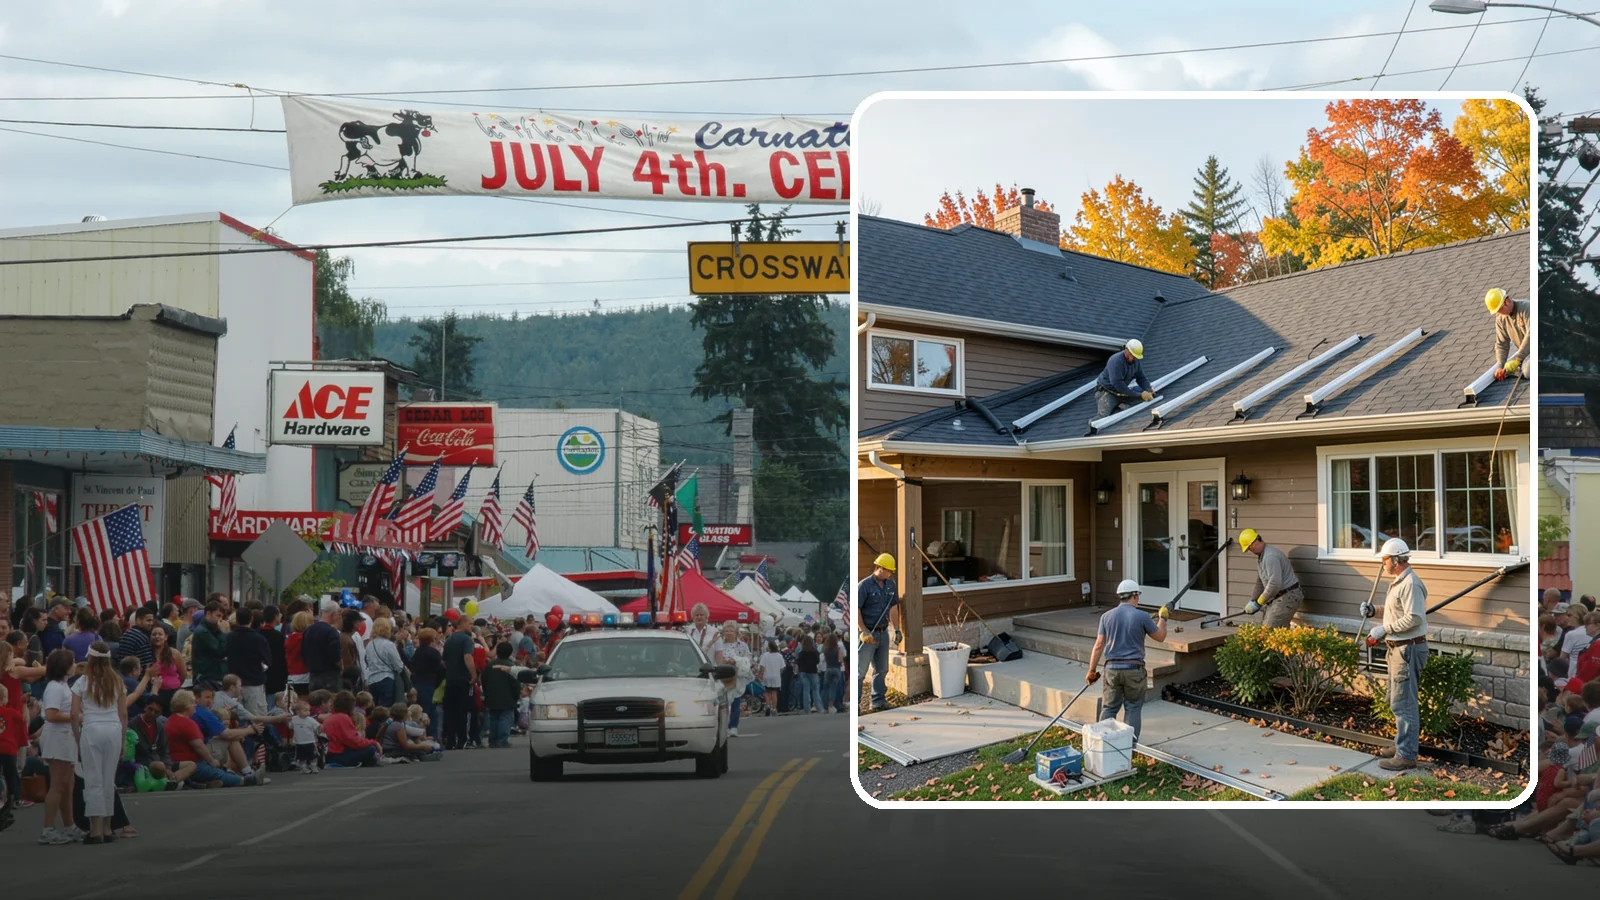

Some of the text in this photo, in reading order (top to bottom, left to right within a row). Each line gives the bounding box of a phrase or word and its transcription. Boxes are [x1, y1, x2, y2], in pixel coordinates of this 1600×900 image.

[481, 141, 604, 192] JULY
[632, 150, 746, 197] 4th.
[697, 254, 850, 280] CROSSWA
[283, 380, 373, 420] ACE
[406, 409, 485, 422] CEDAR LOG
[283, 421, 370, 436] Hardware
[416, 428, 476, 447] Coca-Cola
[95, 485, 124, 495] Vincent
[126, 486, 136, 495] de
[137, 486, 155, 495] Paul
[688, 526, 741, 535] CRNATION
[699, 535, 730, 543] GLASS
